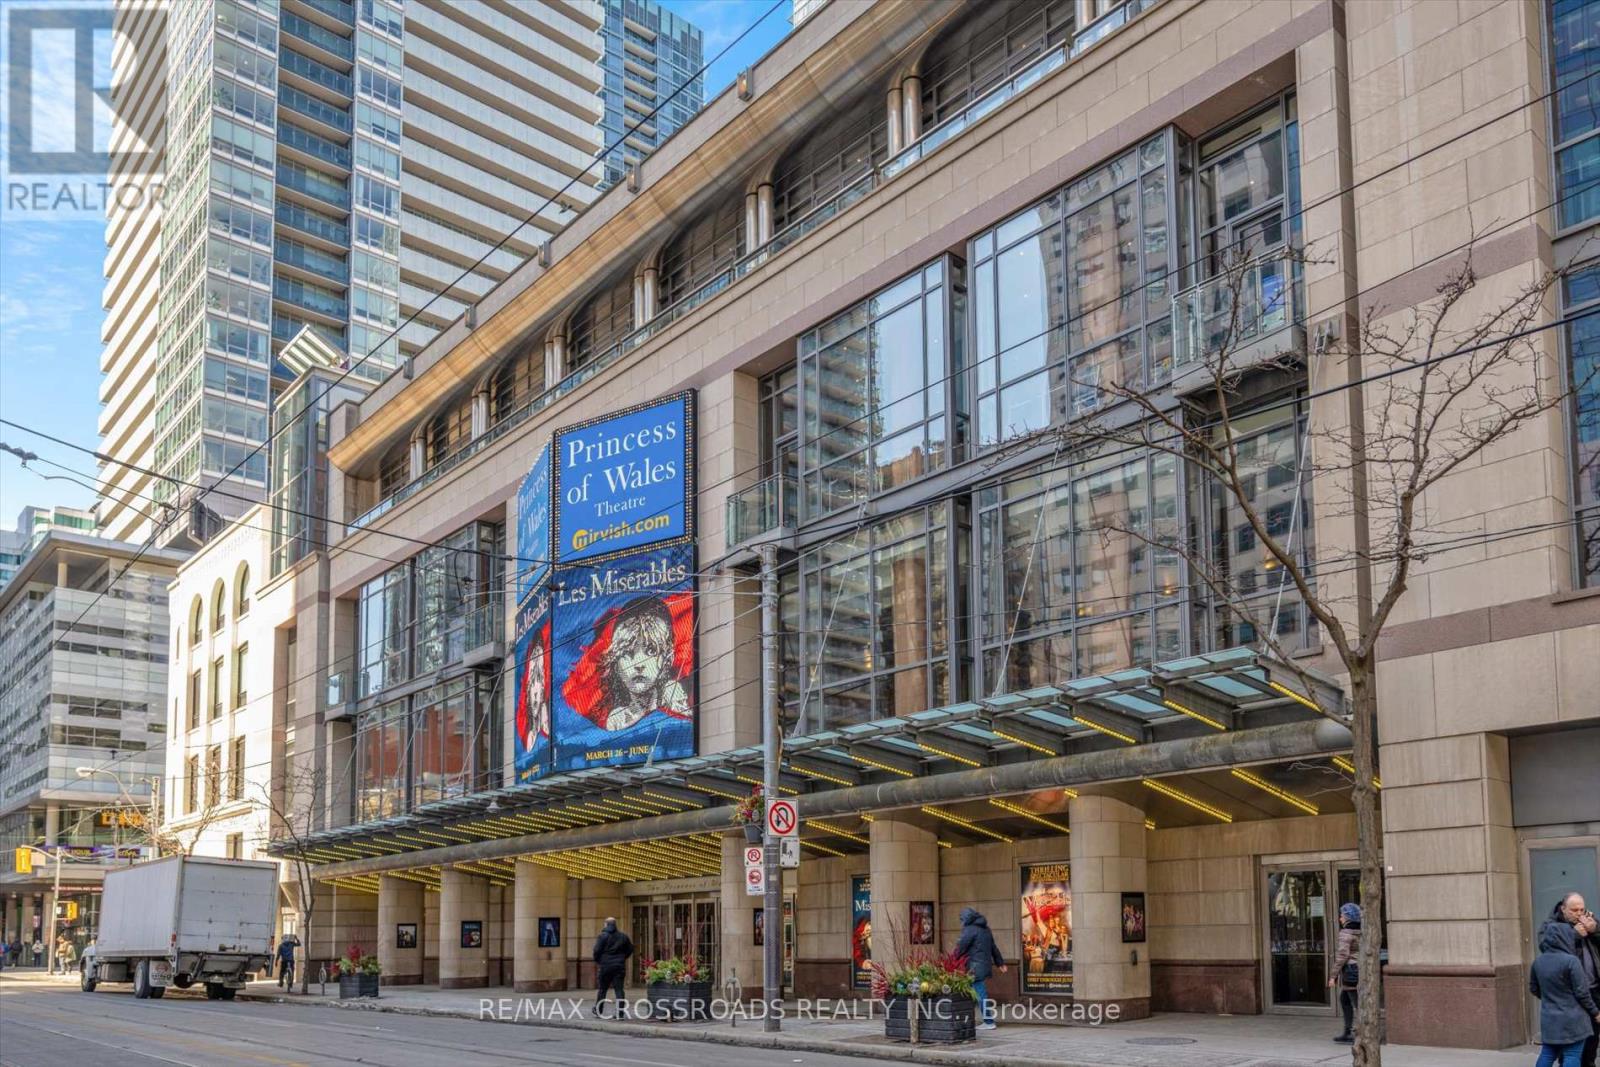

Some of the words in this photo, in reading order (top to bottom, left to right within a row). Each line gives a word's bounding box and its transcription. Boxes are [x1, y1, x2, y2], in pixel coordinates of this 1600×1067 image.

[567, 420, 677, 468] Princess
[567, 473, 592, 505] of
[603, 458, 676, 494] Wales
[594, 496, 646, 517] Theatre
[573, 513, 669, 551] mirvish.com
[558, 581, 587, 606] Les
[590, 558, 686, 599] Misérables
[586, 749, 613, 760] MARCH
[629, 745, 649, 758] JUNE
